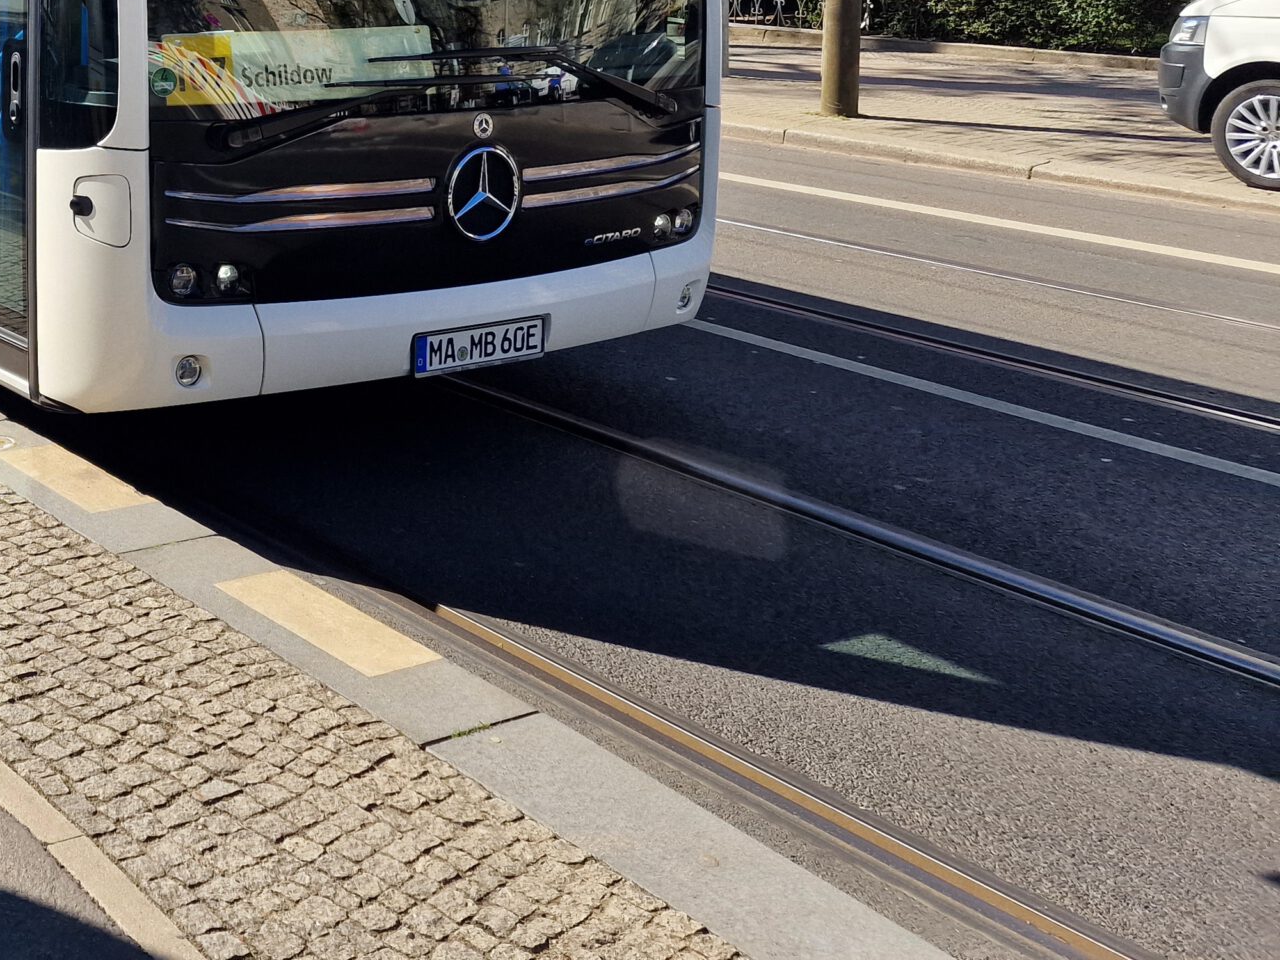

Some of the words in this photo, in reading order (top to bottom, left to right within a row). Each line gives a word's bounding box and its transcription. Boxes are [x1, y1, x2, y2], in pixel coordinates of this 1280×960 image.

[241, 63, 333, 87] Schildow
[428, 337, 456, 367] MA
[470, 331, 496, 360] MB
[500, 324, 538, 354] 60E
